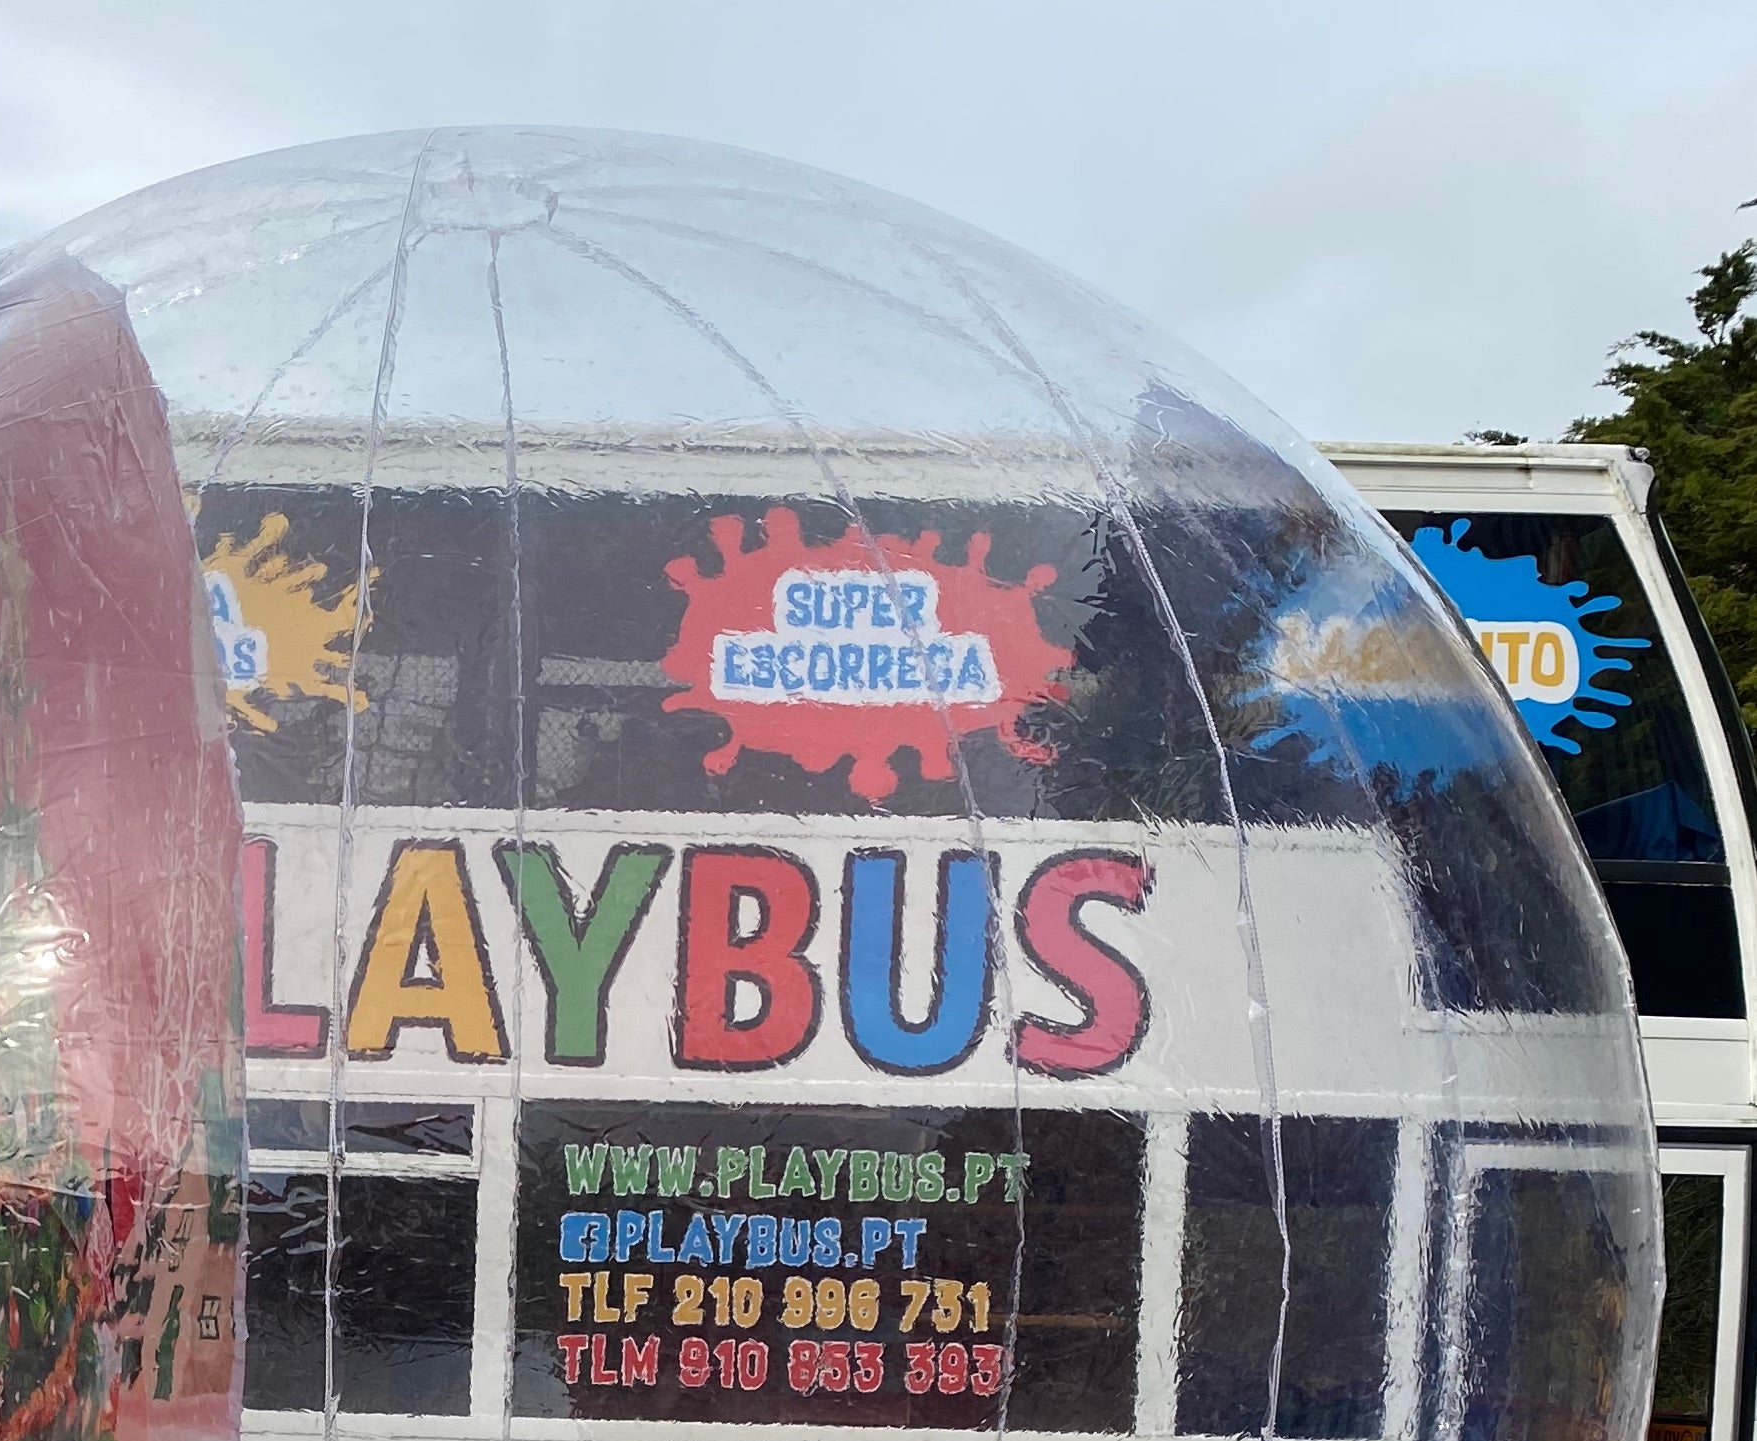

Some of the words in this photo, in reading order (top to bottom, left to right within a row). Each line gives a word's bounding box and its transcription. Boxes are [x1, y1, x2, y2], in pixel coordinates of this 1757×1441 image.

[786, 582, 928, 631] SUPER
[244, 837, 1153, 1080] LAYBUS
[564, 1143, 1031, 1204] WWW.PLAYBUS.PT
[558, 1271, 654, 1324] TLF
[672, 1274, 763, 1329] 210
[899, 1277, 991, 1334] 731
[556, 1333, 660, 1387] TLM
[678, 1336, 768, 1391] 910
[787, 1339, 884, 1395] 853
[904, 1343, 1008, 1396] 393
